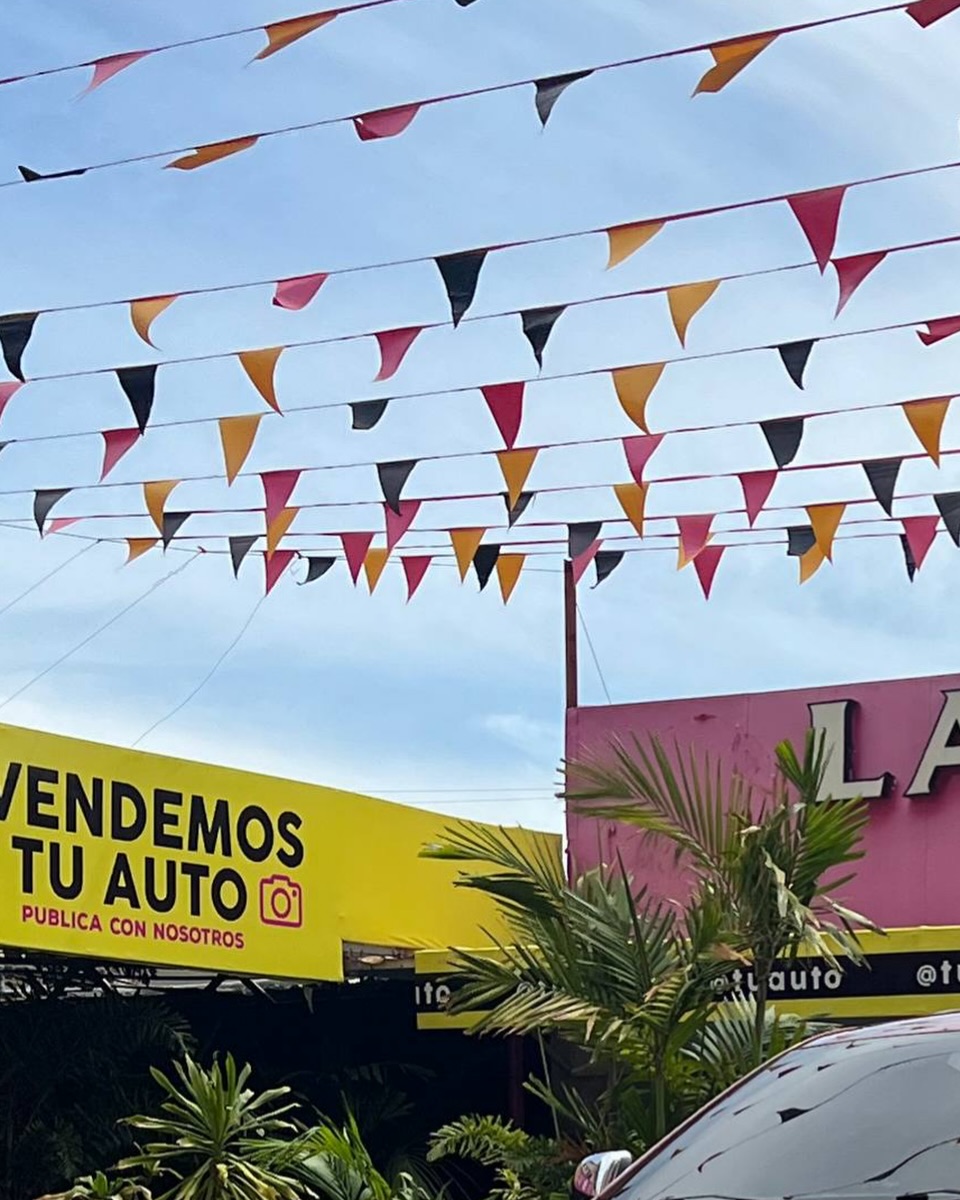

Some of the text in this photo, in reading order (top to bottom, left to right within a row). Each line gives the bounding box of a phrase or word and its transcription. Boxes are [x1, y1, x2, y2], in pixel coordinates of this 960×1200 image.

[12, 835, 247, 922] TU AUTO
[22, 905, 245, 949] PUBLICA CON NOSOTROS
